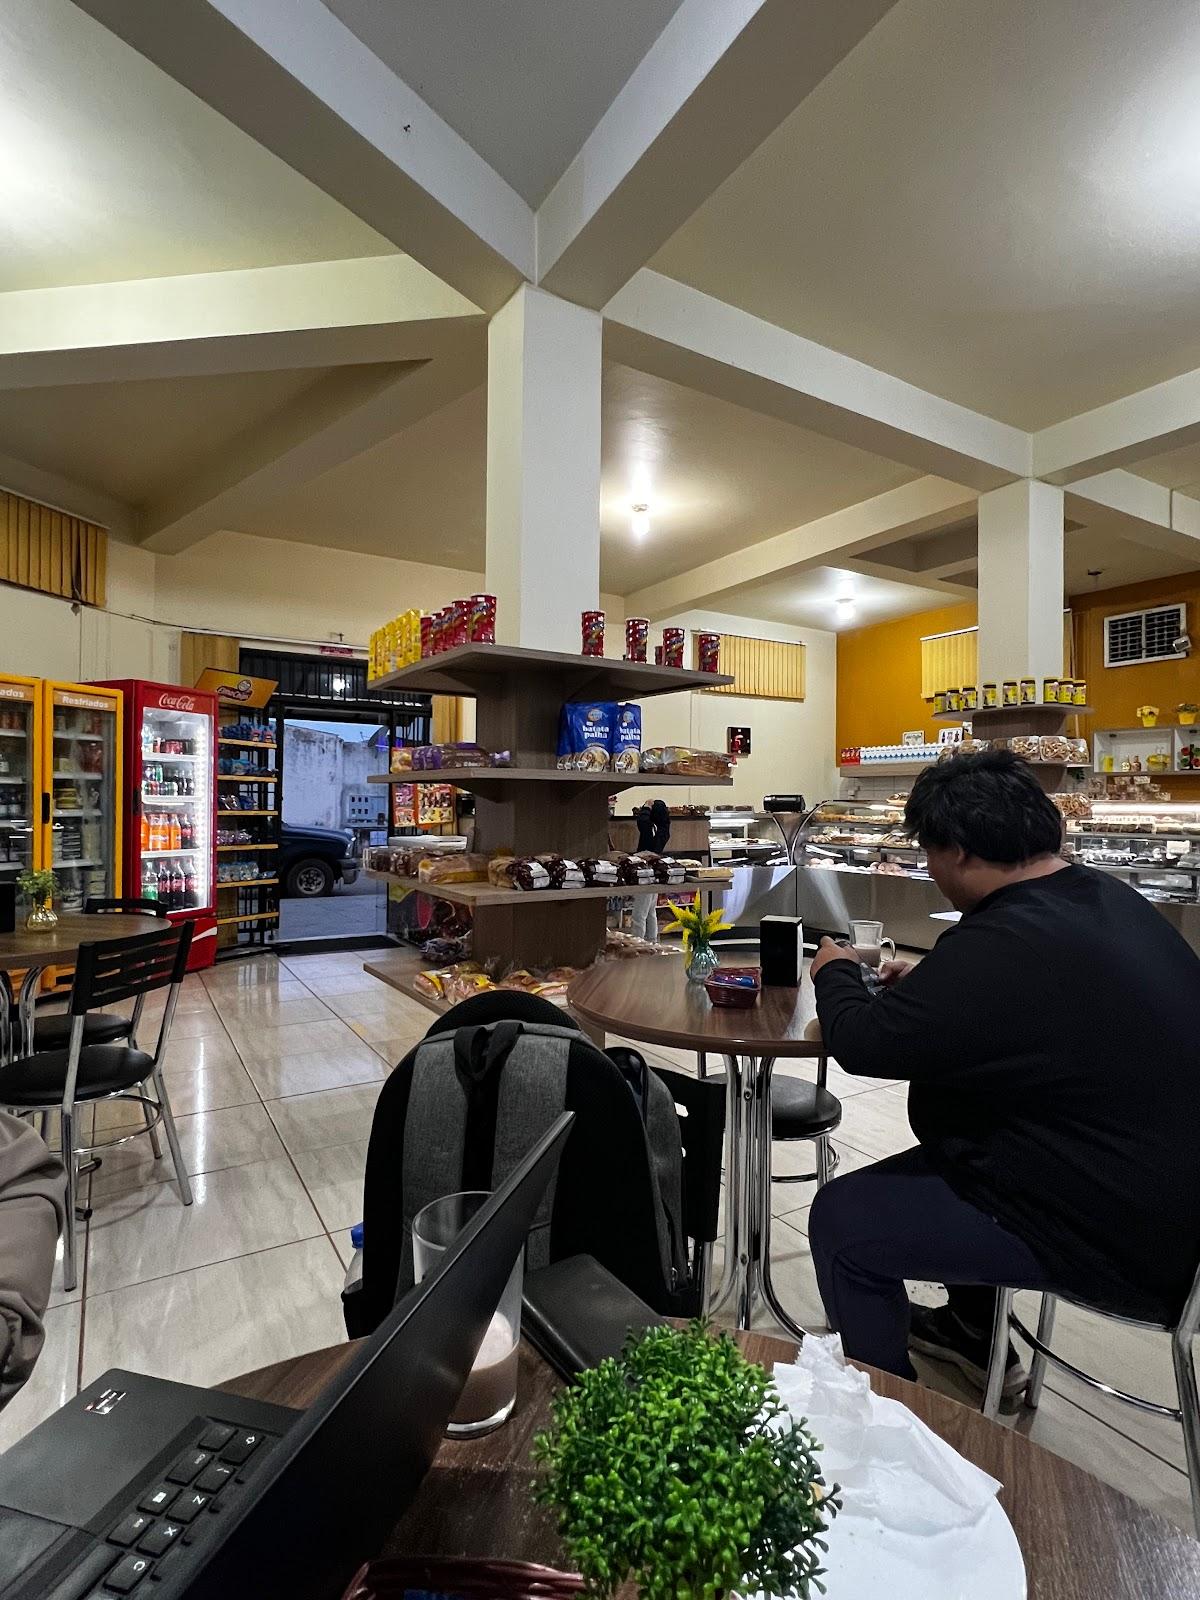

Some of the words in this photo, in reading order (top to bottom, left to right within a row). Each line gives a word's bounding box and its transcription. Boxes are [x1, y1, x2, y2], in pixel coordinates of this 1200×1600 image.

[62, 695, 109, 708] Resfriados
[582, 725, 610, 733] batata
[584, 732, 608, 740] palha
[620, 733, 641, 742] palha
[163, 1526, 178, 1537] X
